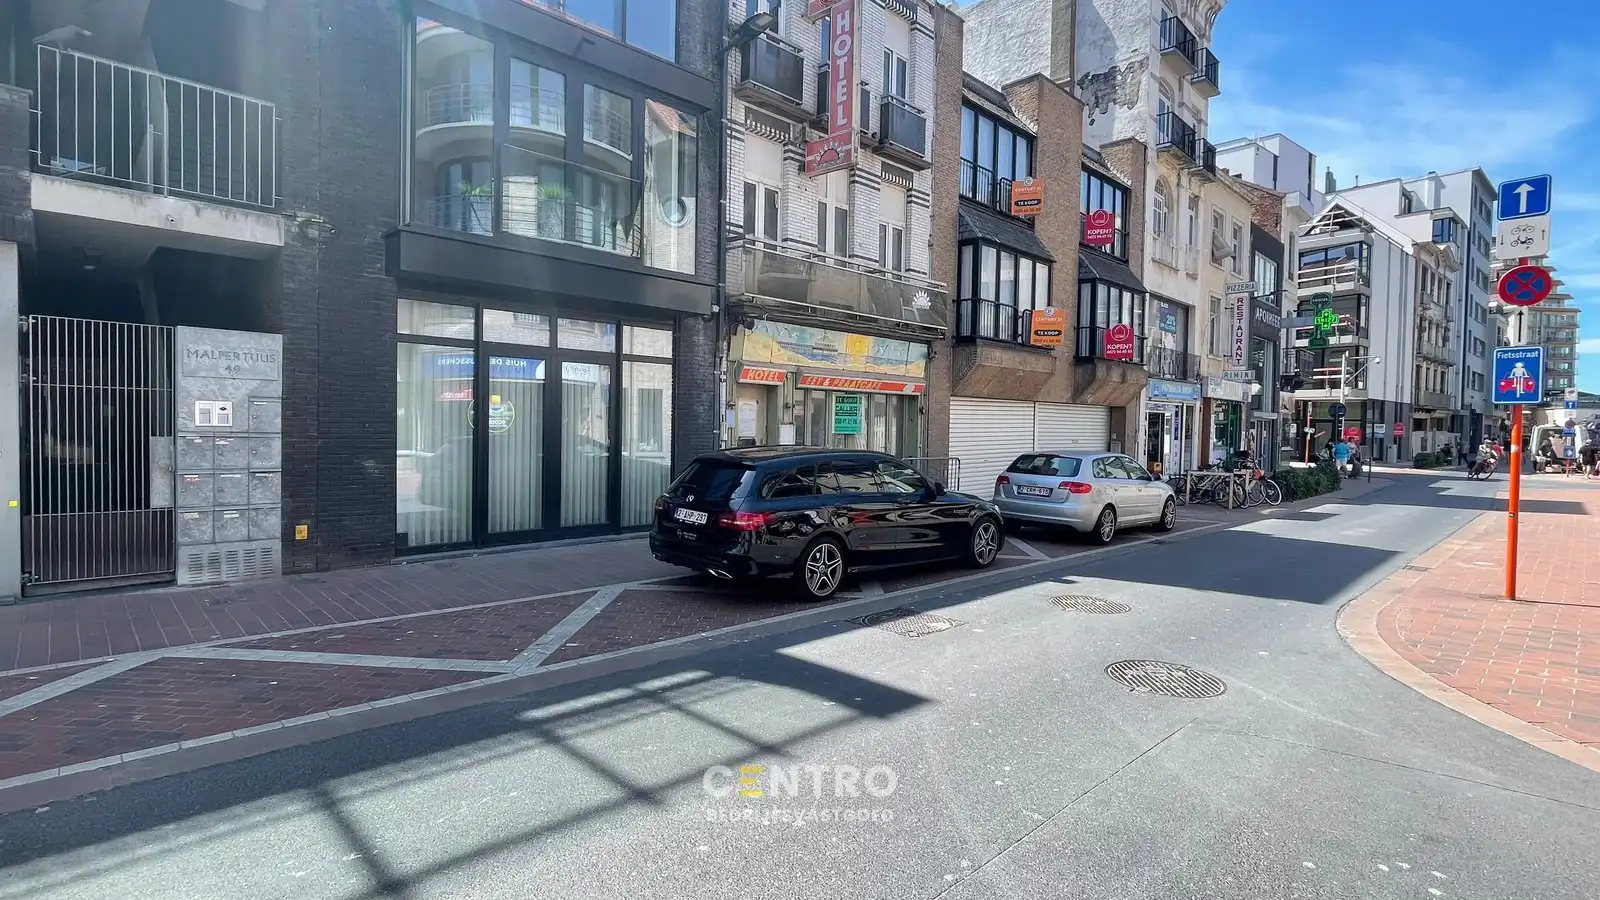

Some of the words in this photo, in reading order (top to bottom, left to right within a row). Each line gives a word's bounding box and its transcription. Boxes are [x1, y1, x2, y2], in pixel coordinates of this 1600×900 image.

[833, 9, 852, 127] HOTEL
[1226, 283, 1255, 292] PIZZERIA
[1235, 297, 1244, 365] RESTAURANT
[1497, 351, 1539, 359] Fietsstraat
[747, 369, 779, 382] HOTEL
[1223, 371, 1254, 379] RIMINI
[806, 376, 822, 385] EET
[823, 378, 831, 386] &
